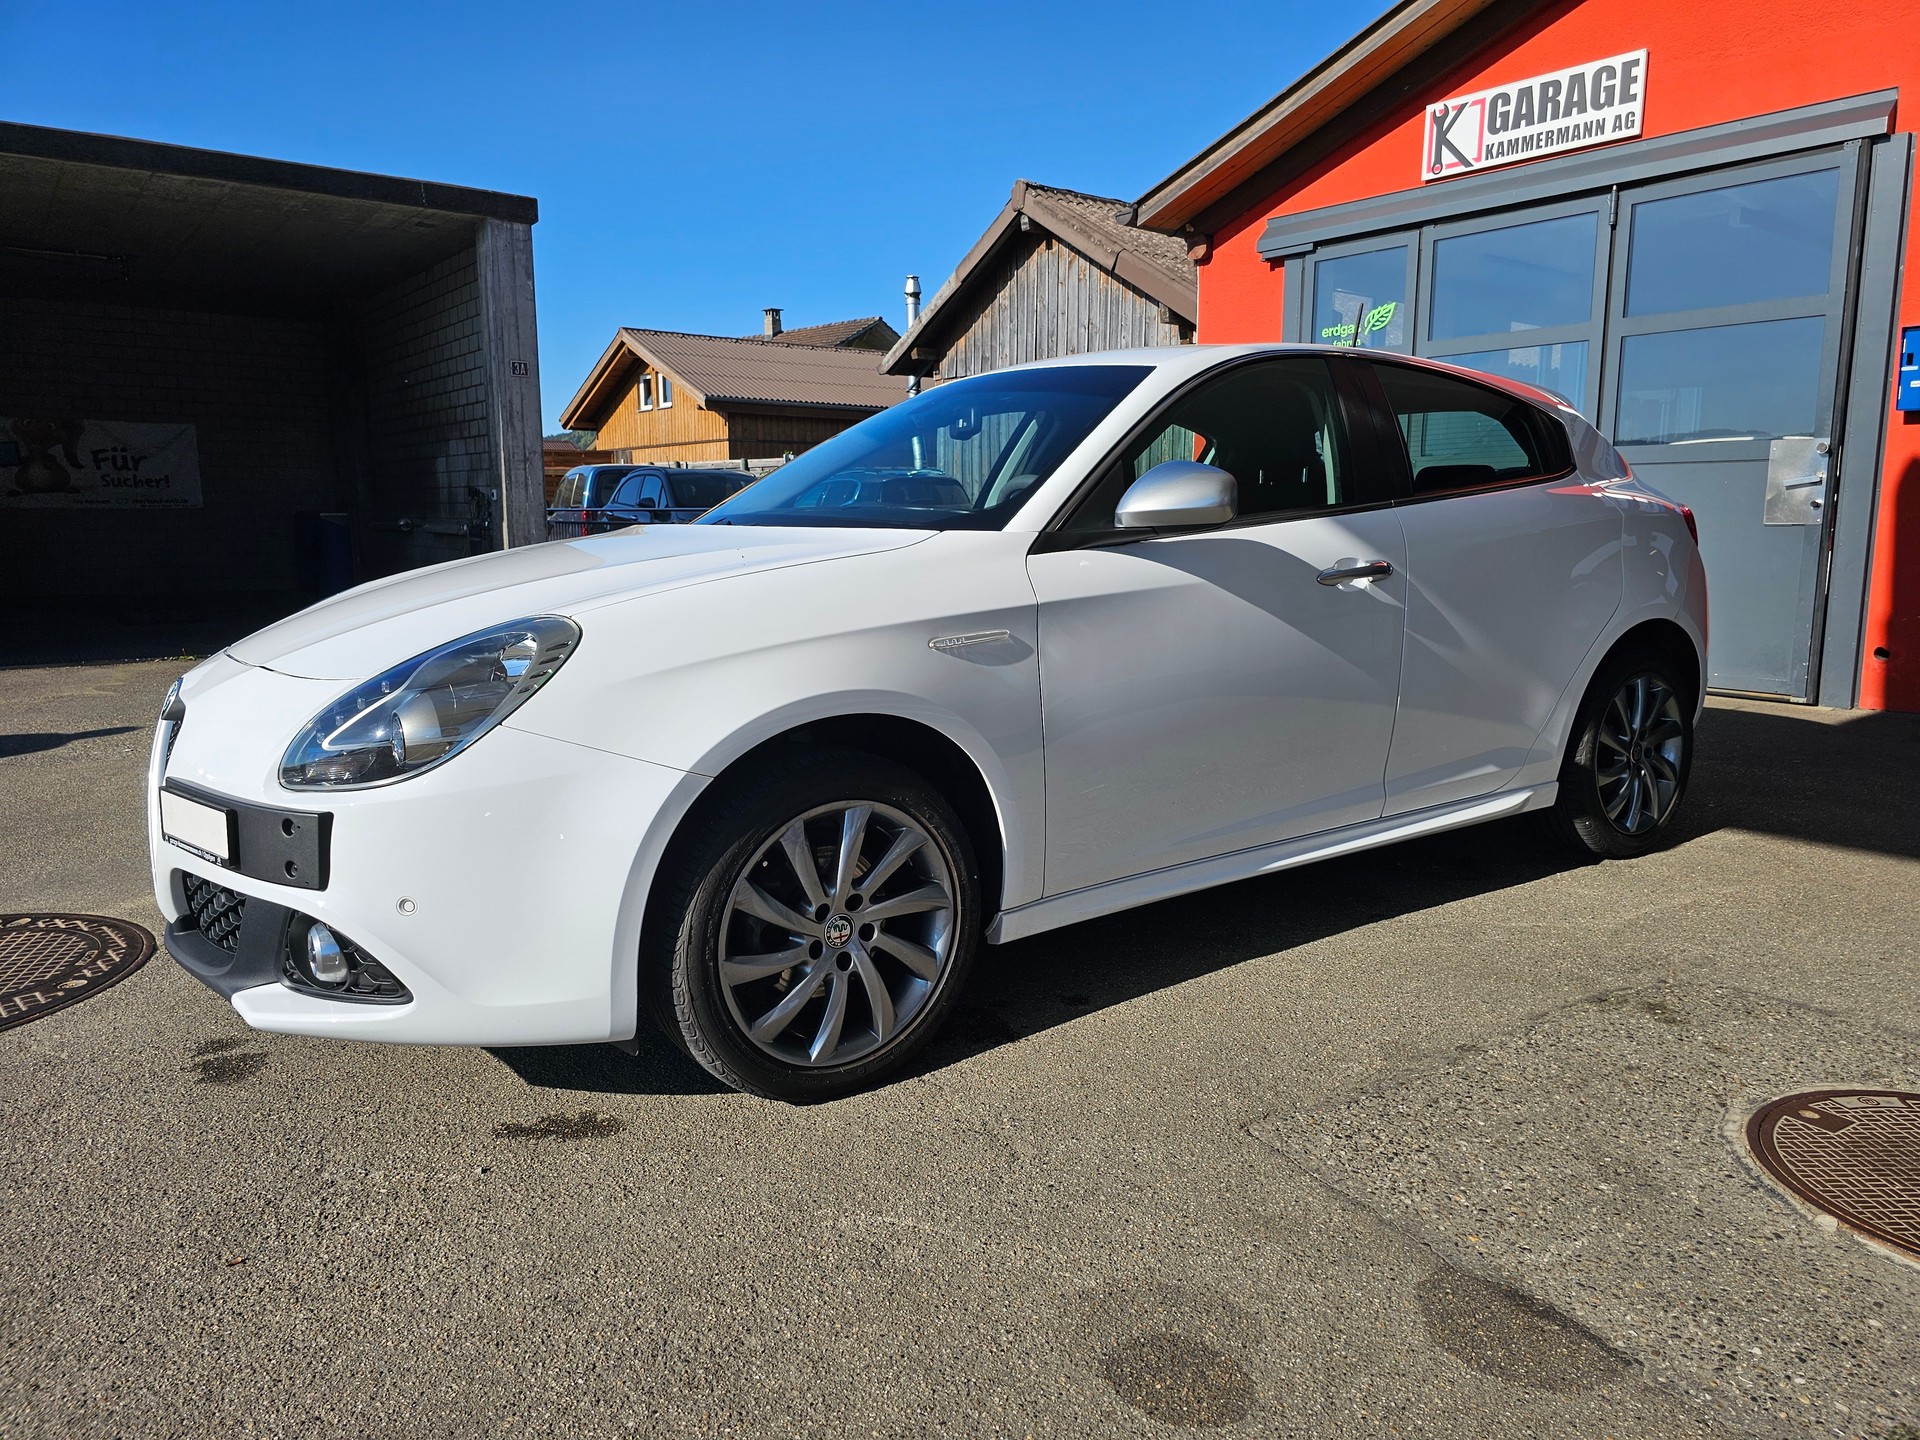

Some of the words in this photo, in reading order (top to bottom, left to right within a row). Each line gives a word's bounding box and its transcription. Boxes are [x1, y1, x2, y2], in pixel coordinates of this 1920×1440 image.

[1487, 58, 1641, 136] GARAGE
[1484, 117, 1606, 161] KAMMERMANN
[1611, 111, 1636, 133] AG
[1332, 338, 1361, 347] fahrn
[514, 362, 526, 375] 3A
[90, 446, 149, 471] Für
[100, 474, 171, 488] Sucher!
